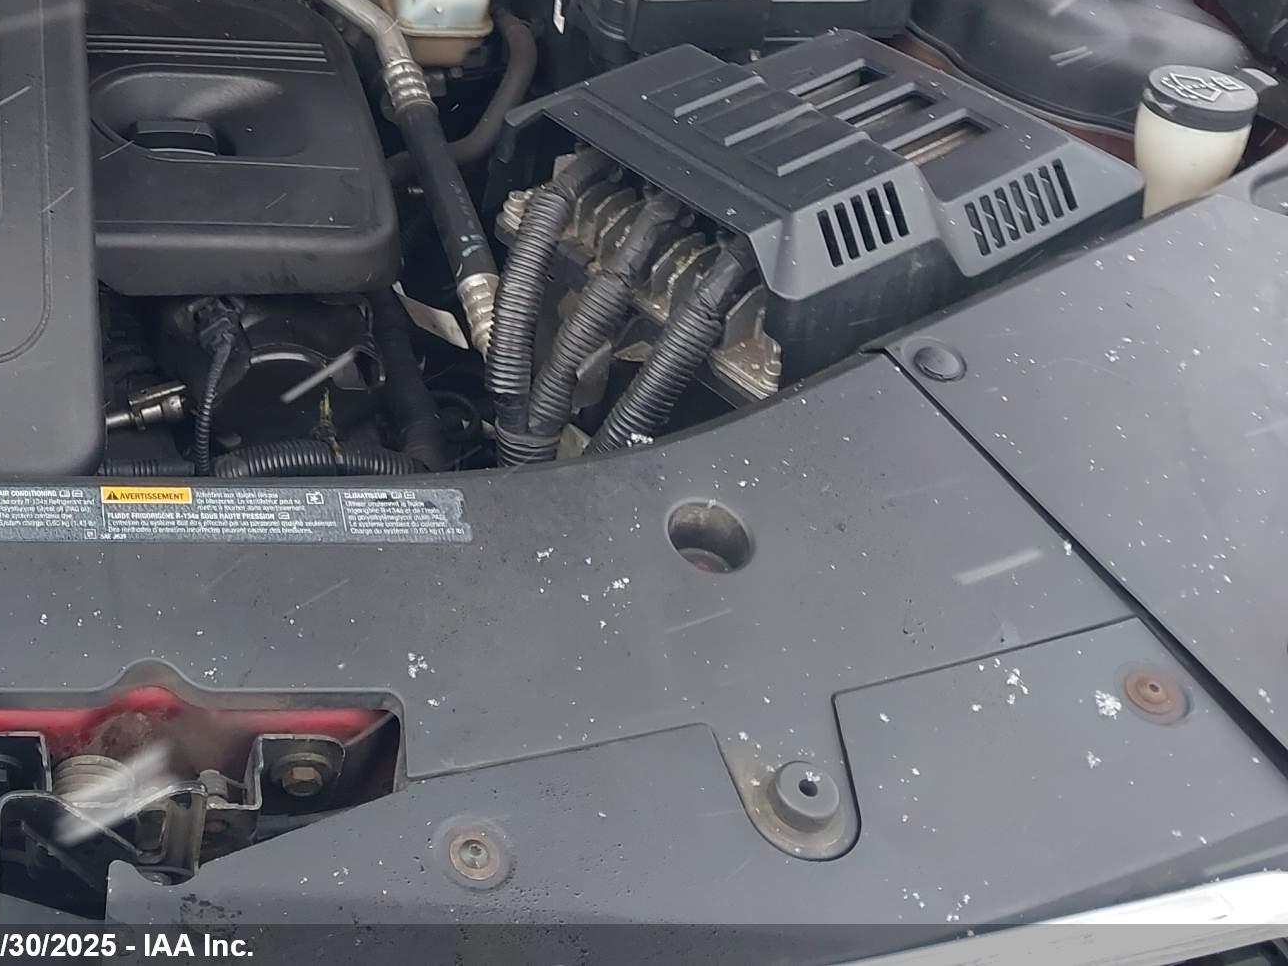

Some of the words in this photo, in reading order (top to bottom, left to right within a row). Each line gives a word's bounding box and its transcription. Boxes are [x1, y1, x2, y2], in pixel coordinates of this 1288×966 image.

[200, 512, 218, 520] SOUS
[219, 512, 240, 520] HAUTE
[242, 512, 275, 520] PRESSION
